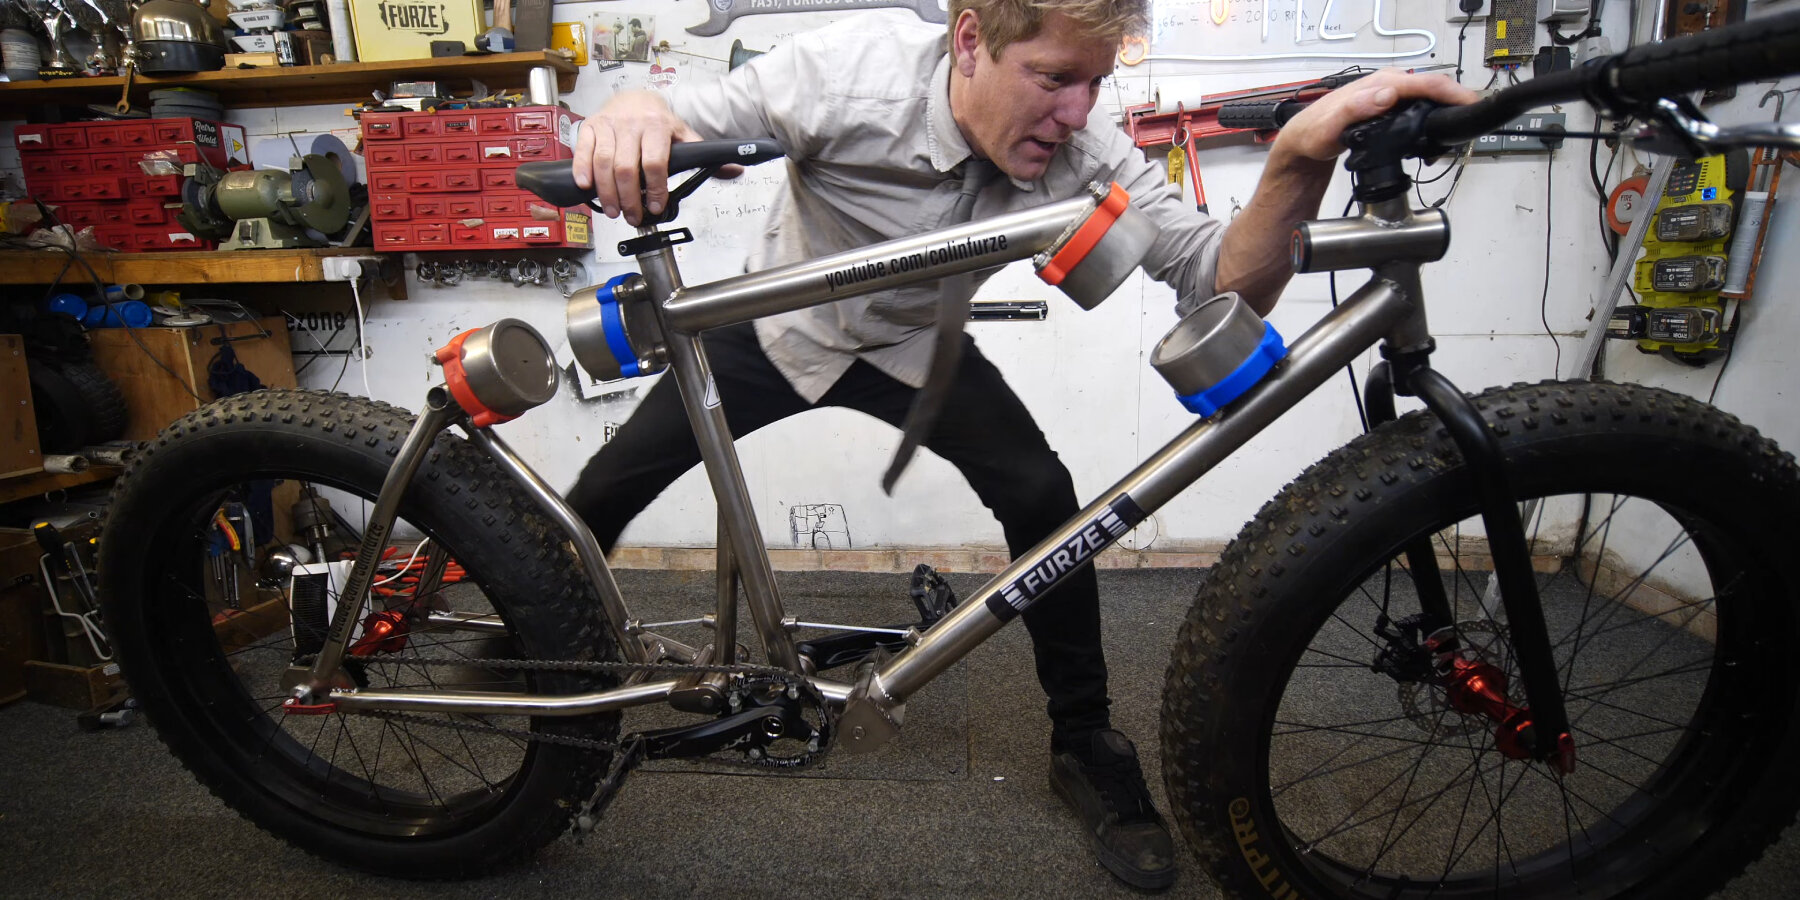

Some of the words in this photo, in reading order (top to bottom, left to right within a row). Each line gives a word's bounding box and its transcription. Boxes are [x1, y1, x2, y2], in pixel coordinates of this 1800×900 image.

[388, 5, 438, 28] FURZE
[194, 120, 216, 133] Retro
[196, 133, 217, 144] Weld
[825, 233, 1008, 292] youtube.com/colinfurze
[1023, 524, 1105, 596] FURZE
